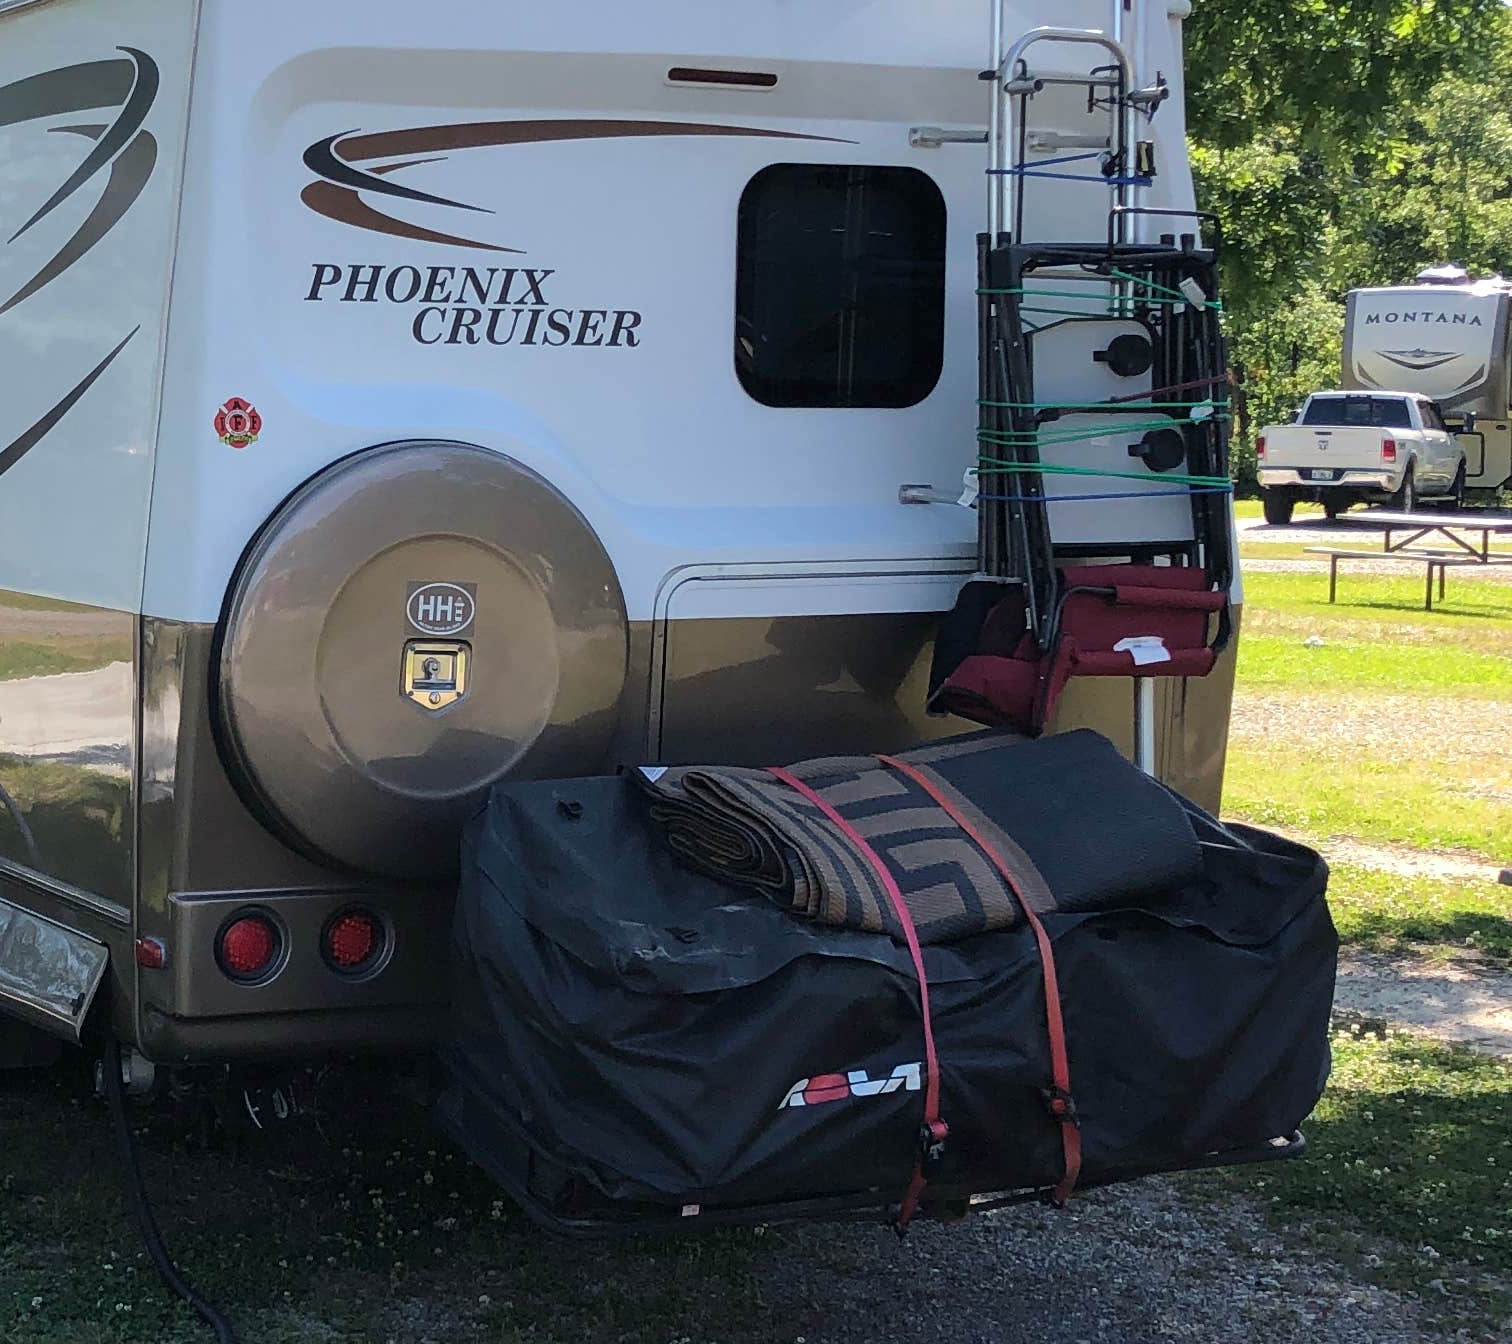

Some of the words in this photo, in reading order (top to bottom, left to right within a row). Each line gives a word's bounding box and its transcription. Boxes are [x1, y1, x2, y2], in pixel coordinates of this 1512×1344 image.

[303, 263, 555, 306] PHOENIX
[412, 306, 642, 347] CRUISER
[1365, 312, 1482, 326] MONTANA
